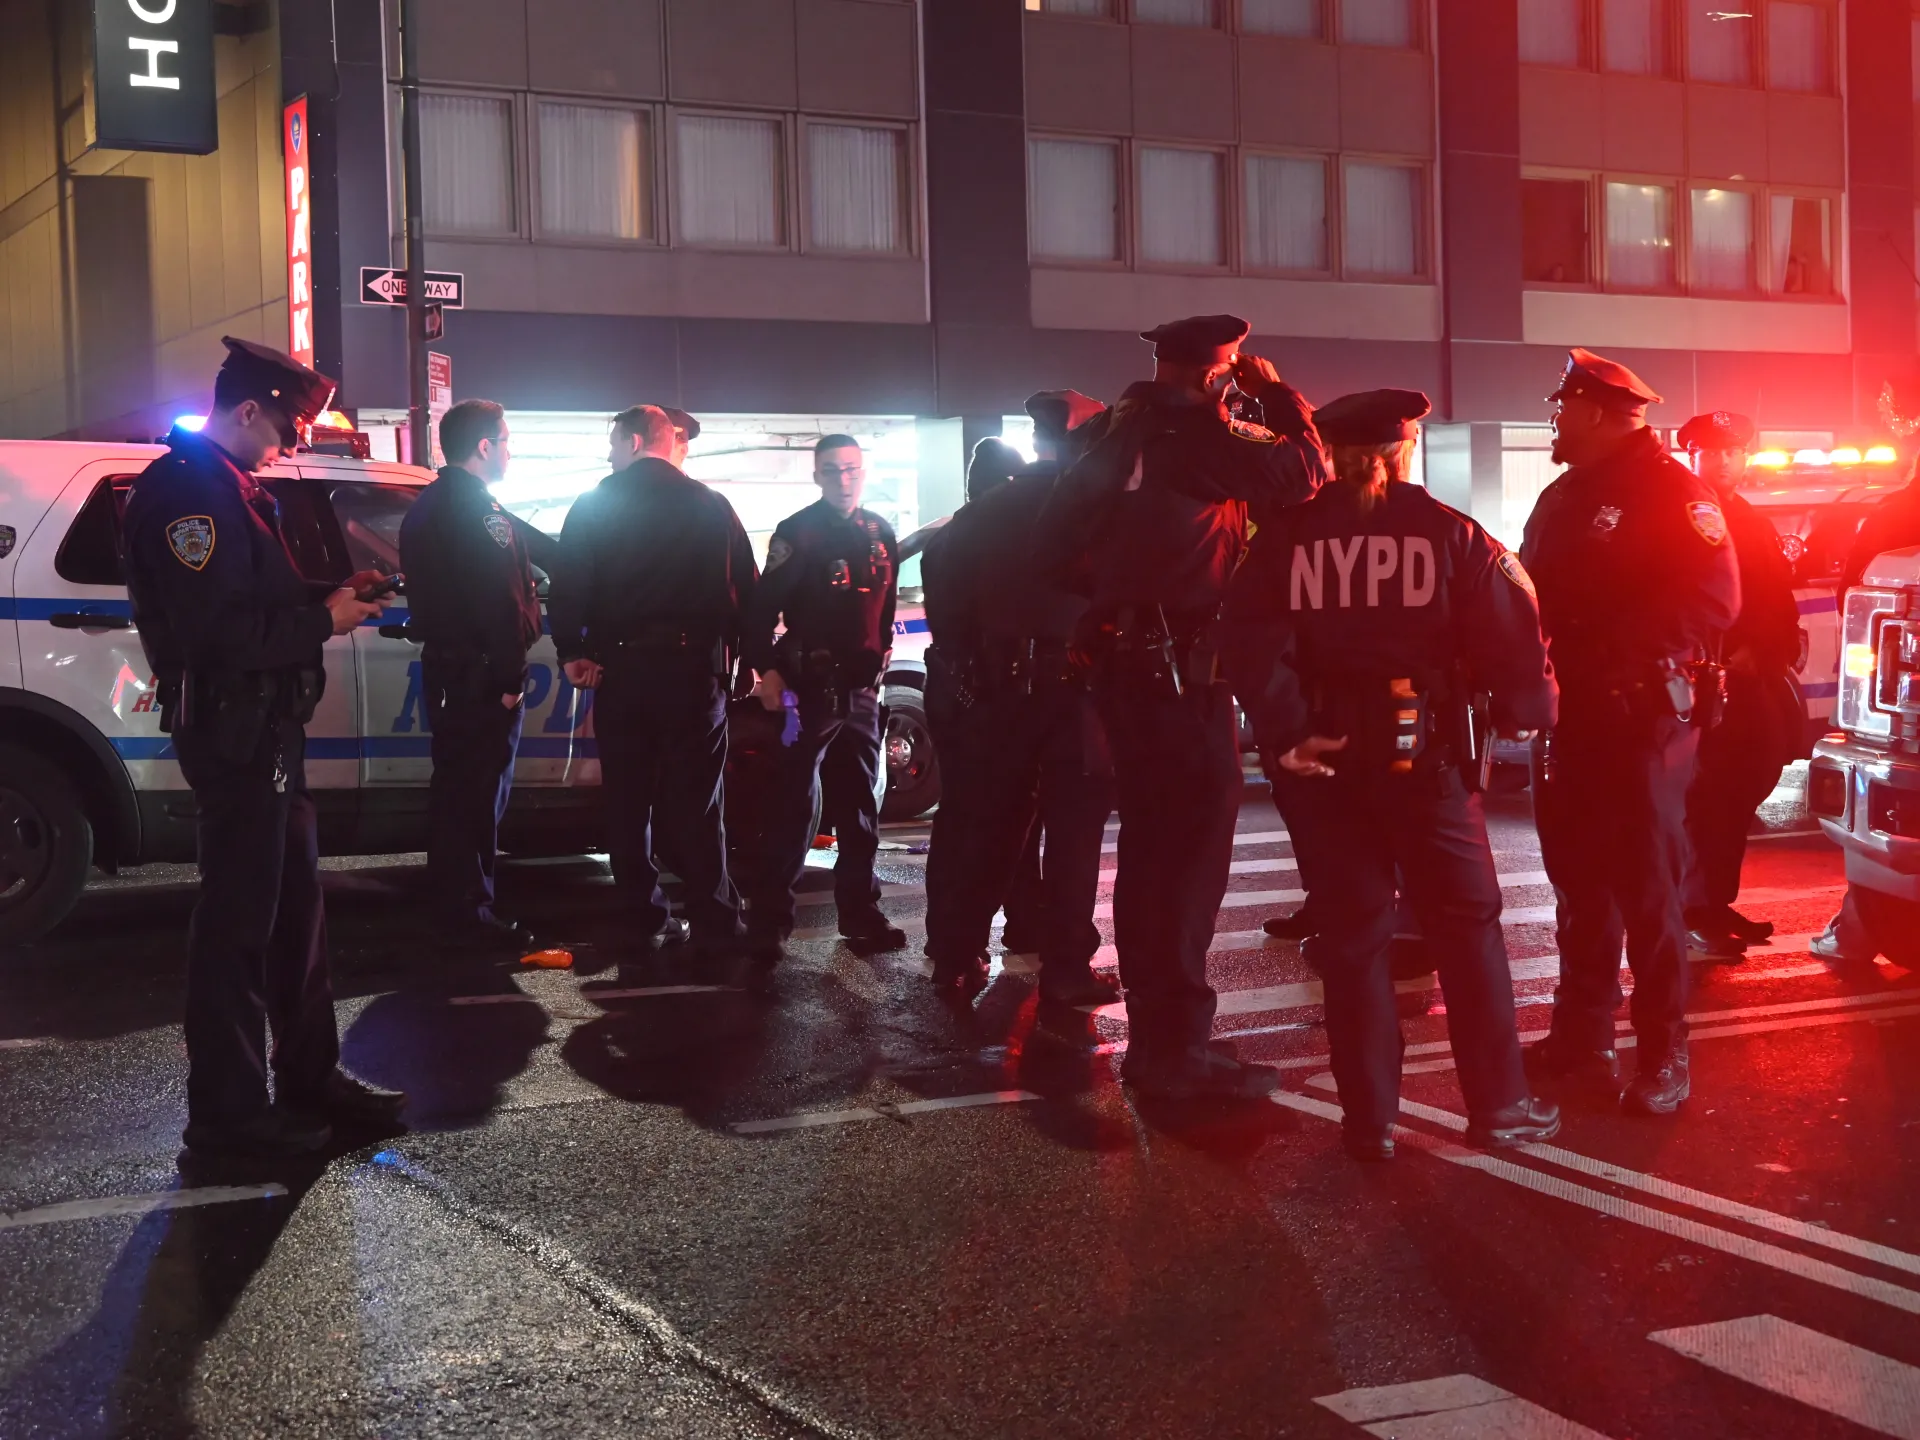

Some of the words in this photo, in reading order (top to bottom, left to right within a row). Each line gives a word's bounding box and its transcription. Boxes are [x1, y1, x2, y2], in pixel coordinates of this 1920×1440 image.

[290, 166, 310, 367] PARK
[381, 280, 407, 294] ONE
[424, 284, 452, 297] WAY
[177, 519, 199, 529] POLICE
[1290, 535, 1436, 610] NYPD
